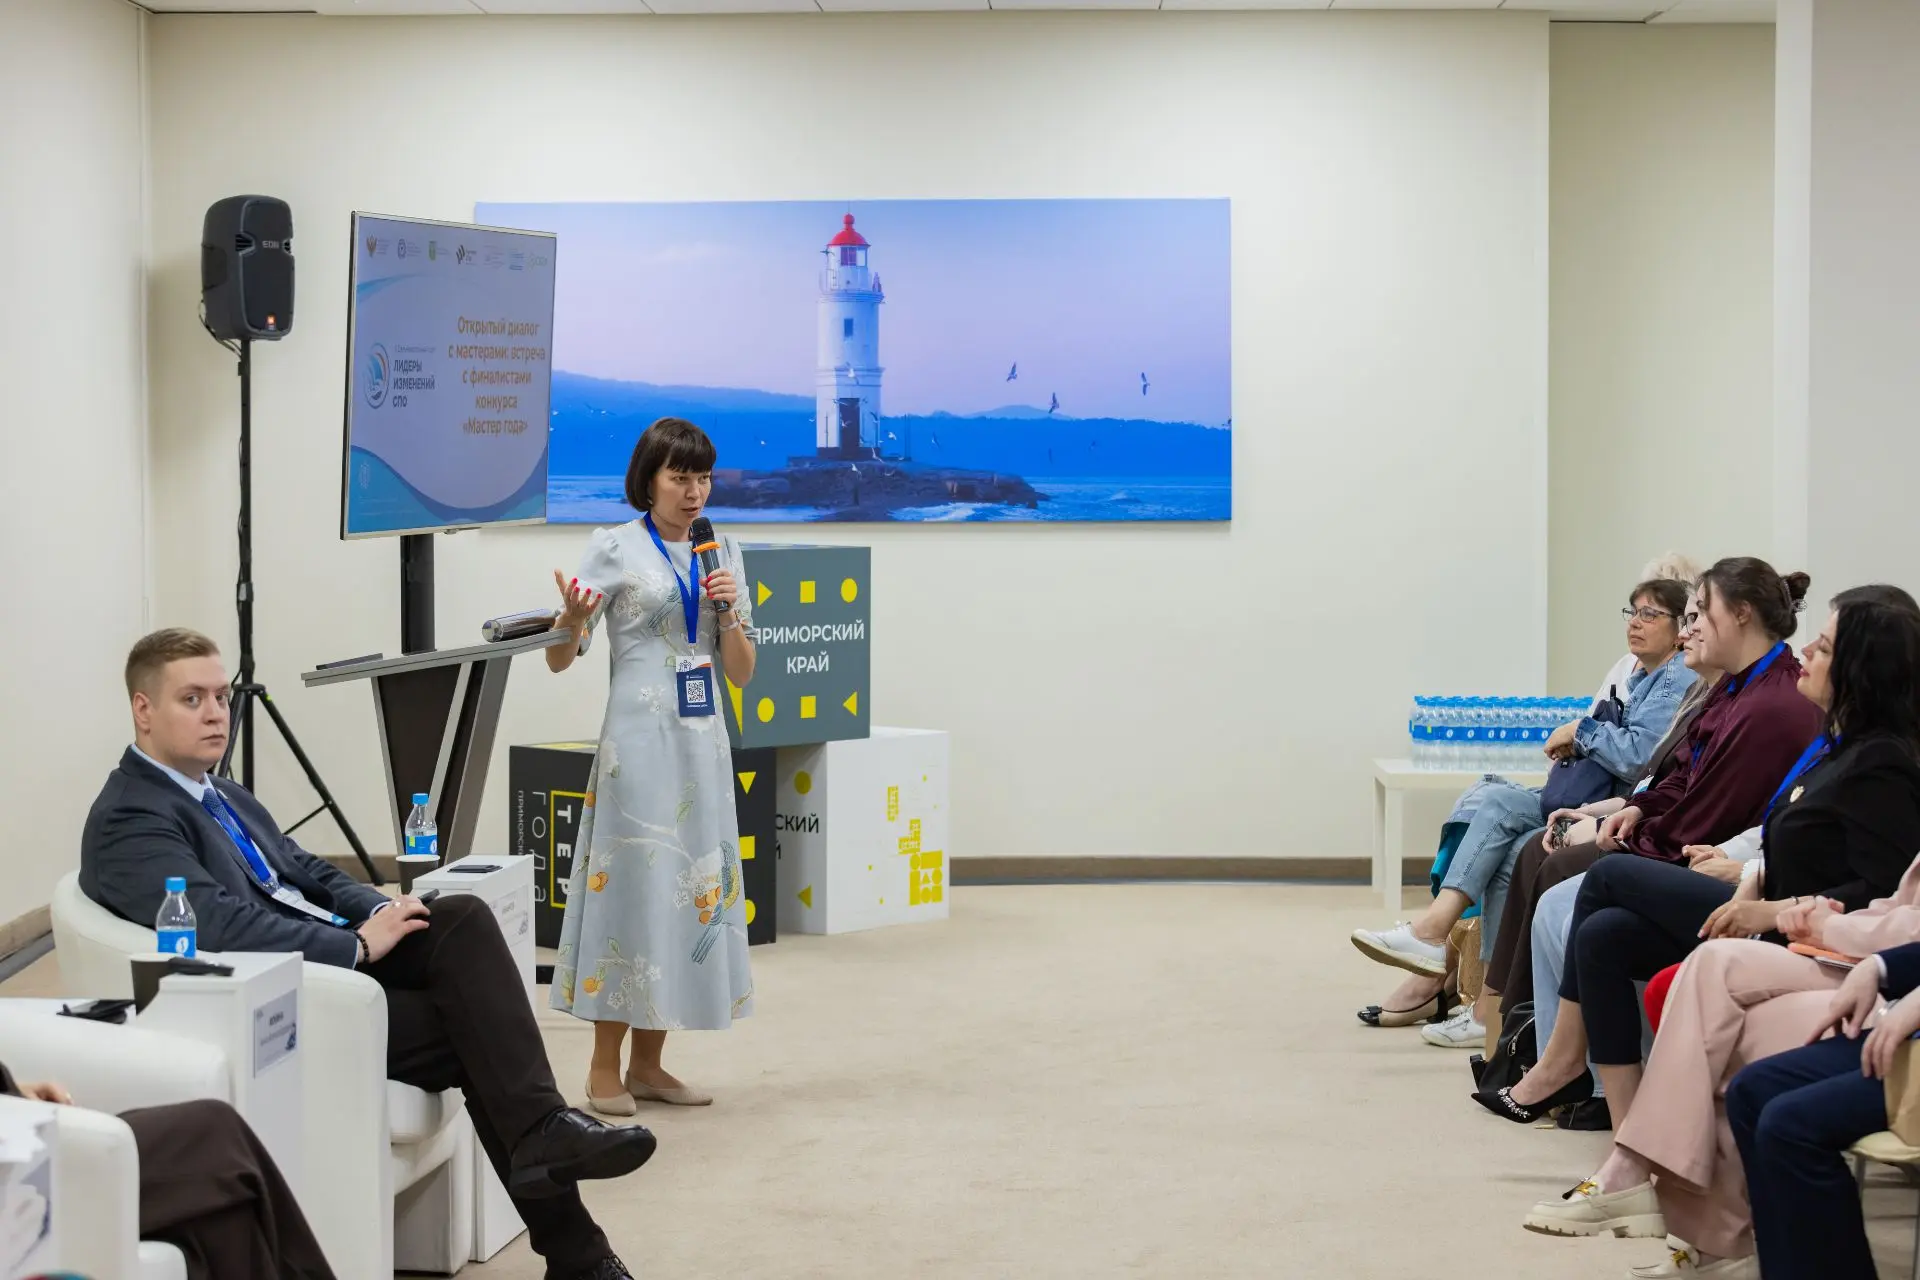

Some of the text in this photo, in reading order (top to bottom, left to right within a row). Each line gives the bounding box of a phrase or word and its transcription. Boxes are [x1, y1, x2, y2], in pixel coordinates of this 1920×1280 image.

[457, 316, 541, 338] Открытый диалог
[448, 345, 454, 358] с
[456, 344, 509, 362] мастерами:
[511, 346, 546, 364] встреча
[393, 359, 423, 375] ЛИДЕРЫ
[462, 366, 532, 388] с финалистами
[393, 375, 435, 390] ИЗМЕНЕНИЙ
[392, 395, 408, 408] СПО
[475, 394, 518, 413] конкурса
[462, 416, 529, 437] «Мастер года»
[787, 650, 830, 674] КРАЙ
